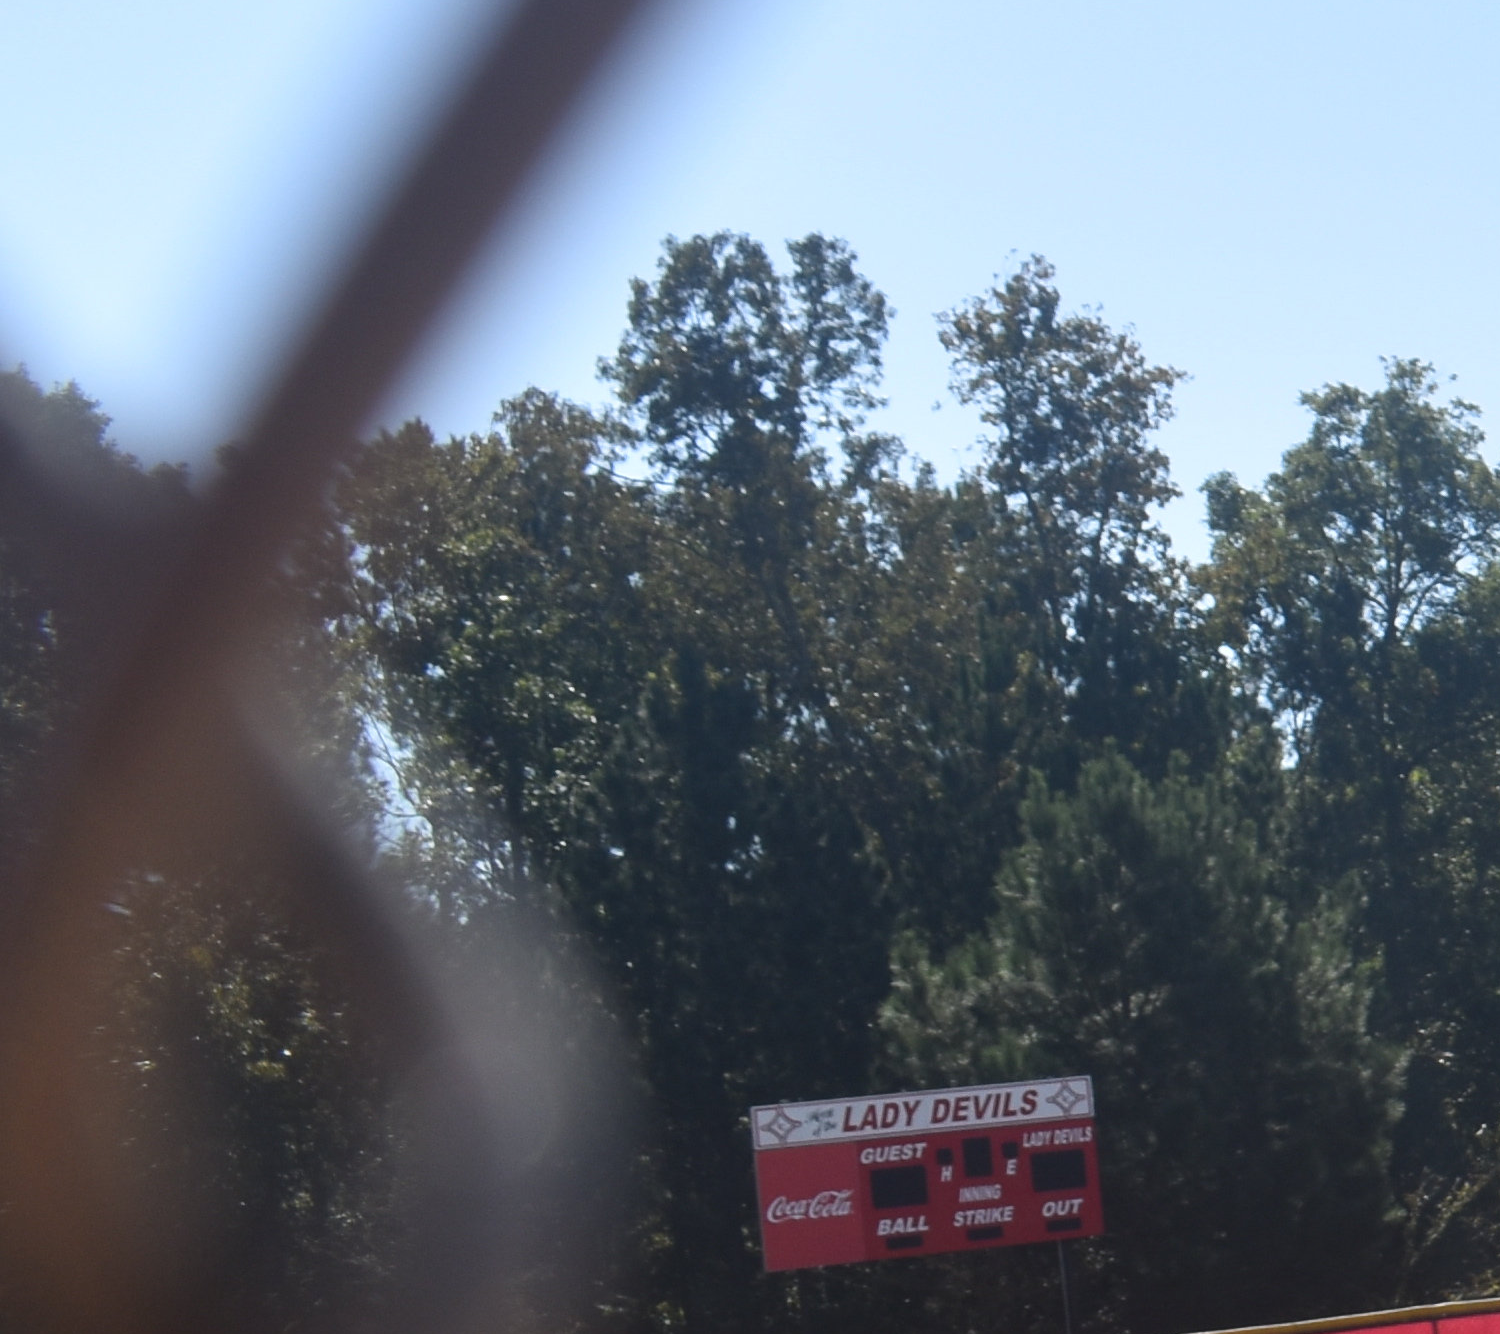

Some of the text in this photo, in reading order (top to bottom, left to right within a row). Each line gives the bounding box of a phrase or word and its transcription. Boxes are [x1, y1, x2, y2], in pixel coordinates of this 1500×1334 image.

[843, 1100, 921, 1132] LADY
[930, 1089, 1039, 1123] DEVILS
[1023, 1127, 1092, 1148] LADY DEVILS
[861, 1142, 927, 1165] GUEST
[940, 1166, 952, 1182] H
[1006, 1159, 1017, 1175] E
[958, 1184, 1001, 1202] INNING
[953, 1206, 1013, 1227] STRIKE
[1042, 1199, 1083, 1218] OUT
[877, 1216, 929, 1236] BALL
